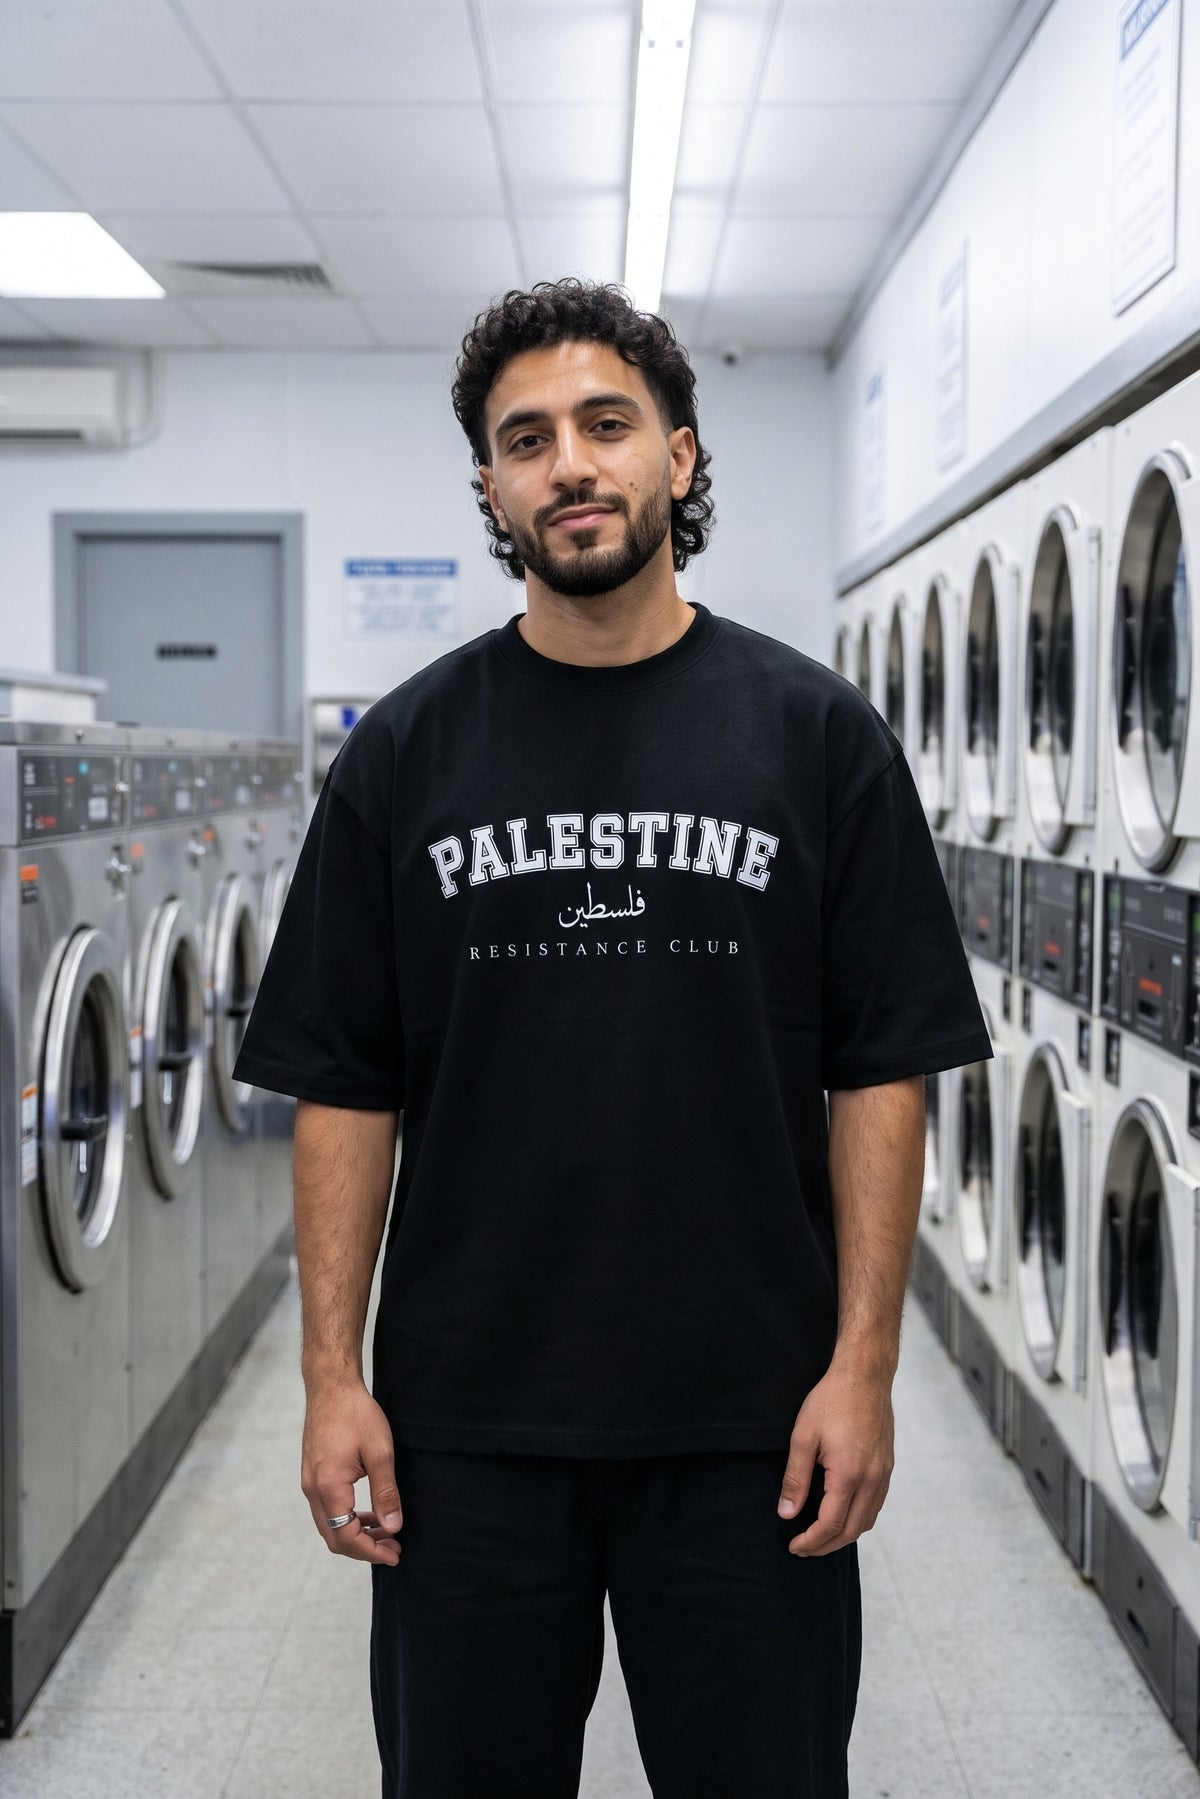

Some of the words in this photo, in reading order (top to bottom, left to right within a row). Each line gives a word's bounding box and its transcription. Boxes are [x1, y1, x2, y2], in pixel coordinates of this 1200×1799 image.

[428, 812, 780, 899] PALESTINE
[558, 882, 646, 928] فلسطين
[469, 940, 647, 960] RESISTANCE
[669, 939, 739, 954] CLUB
